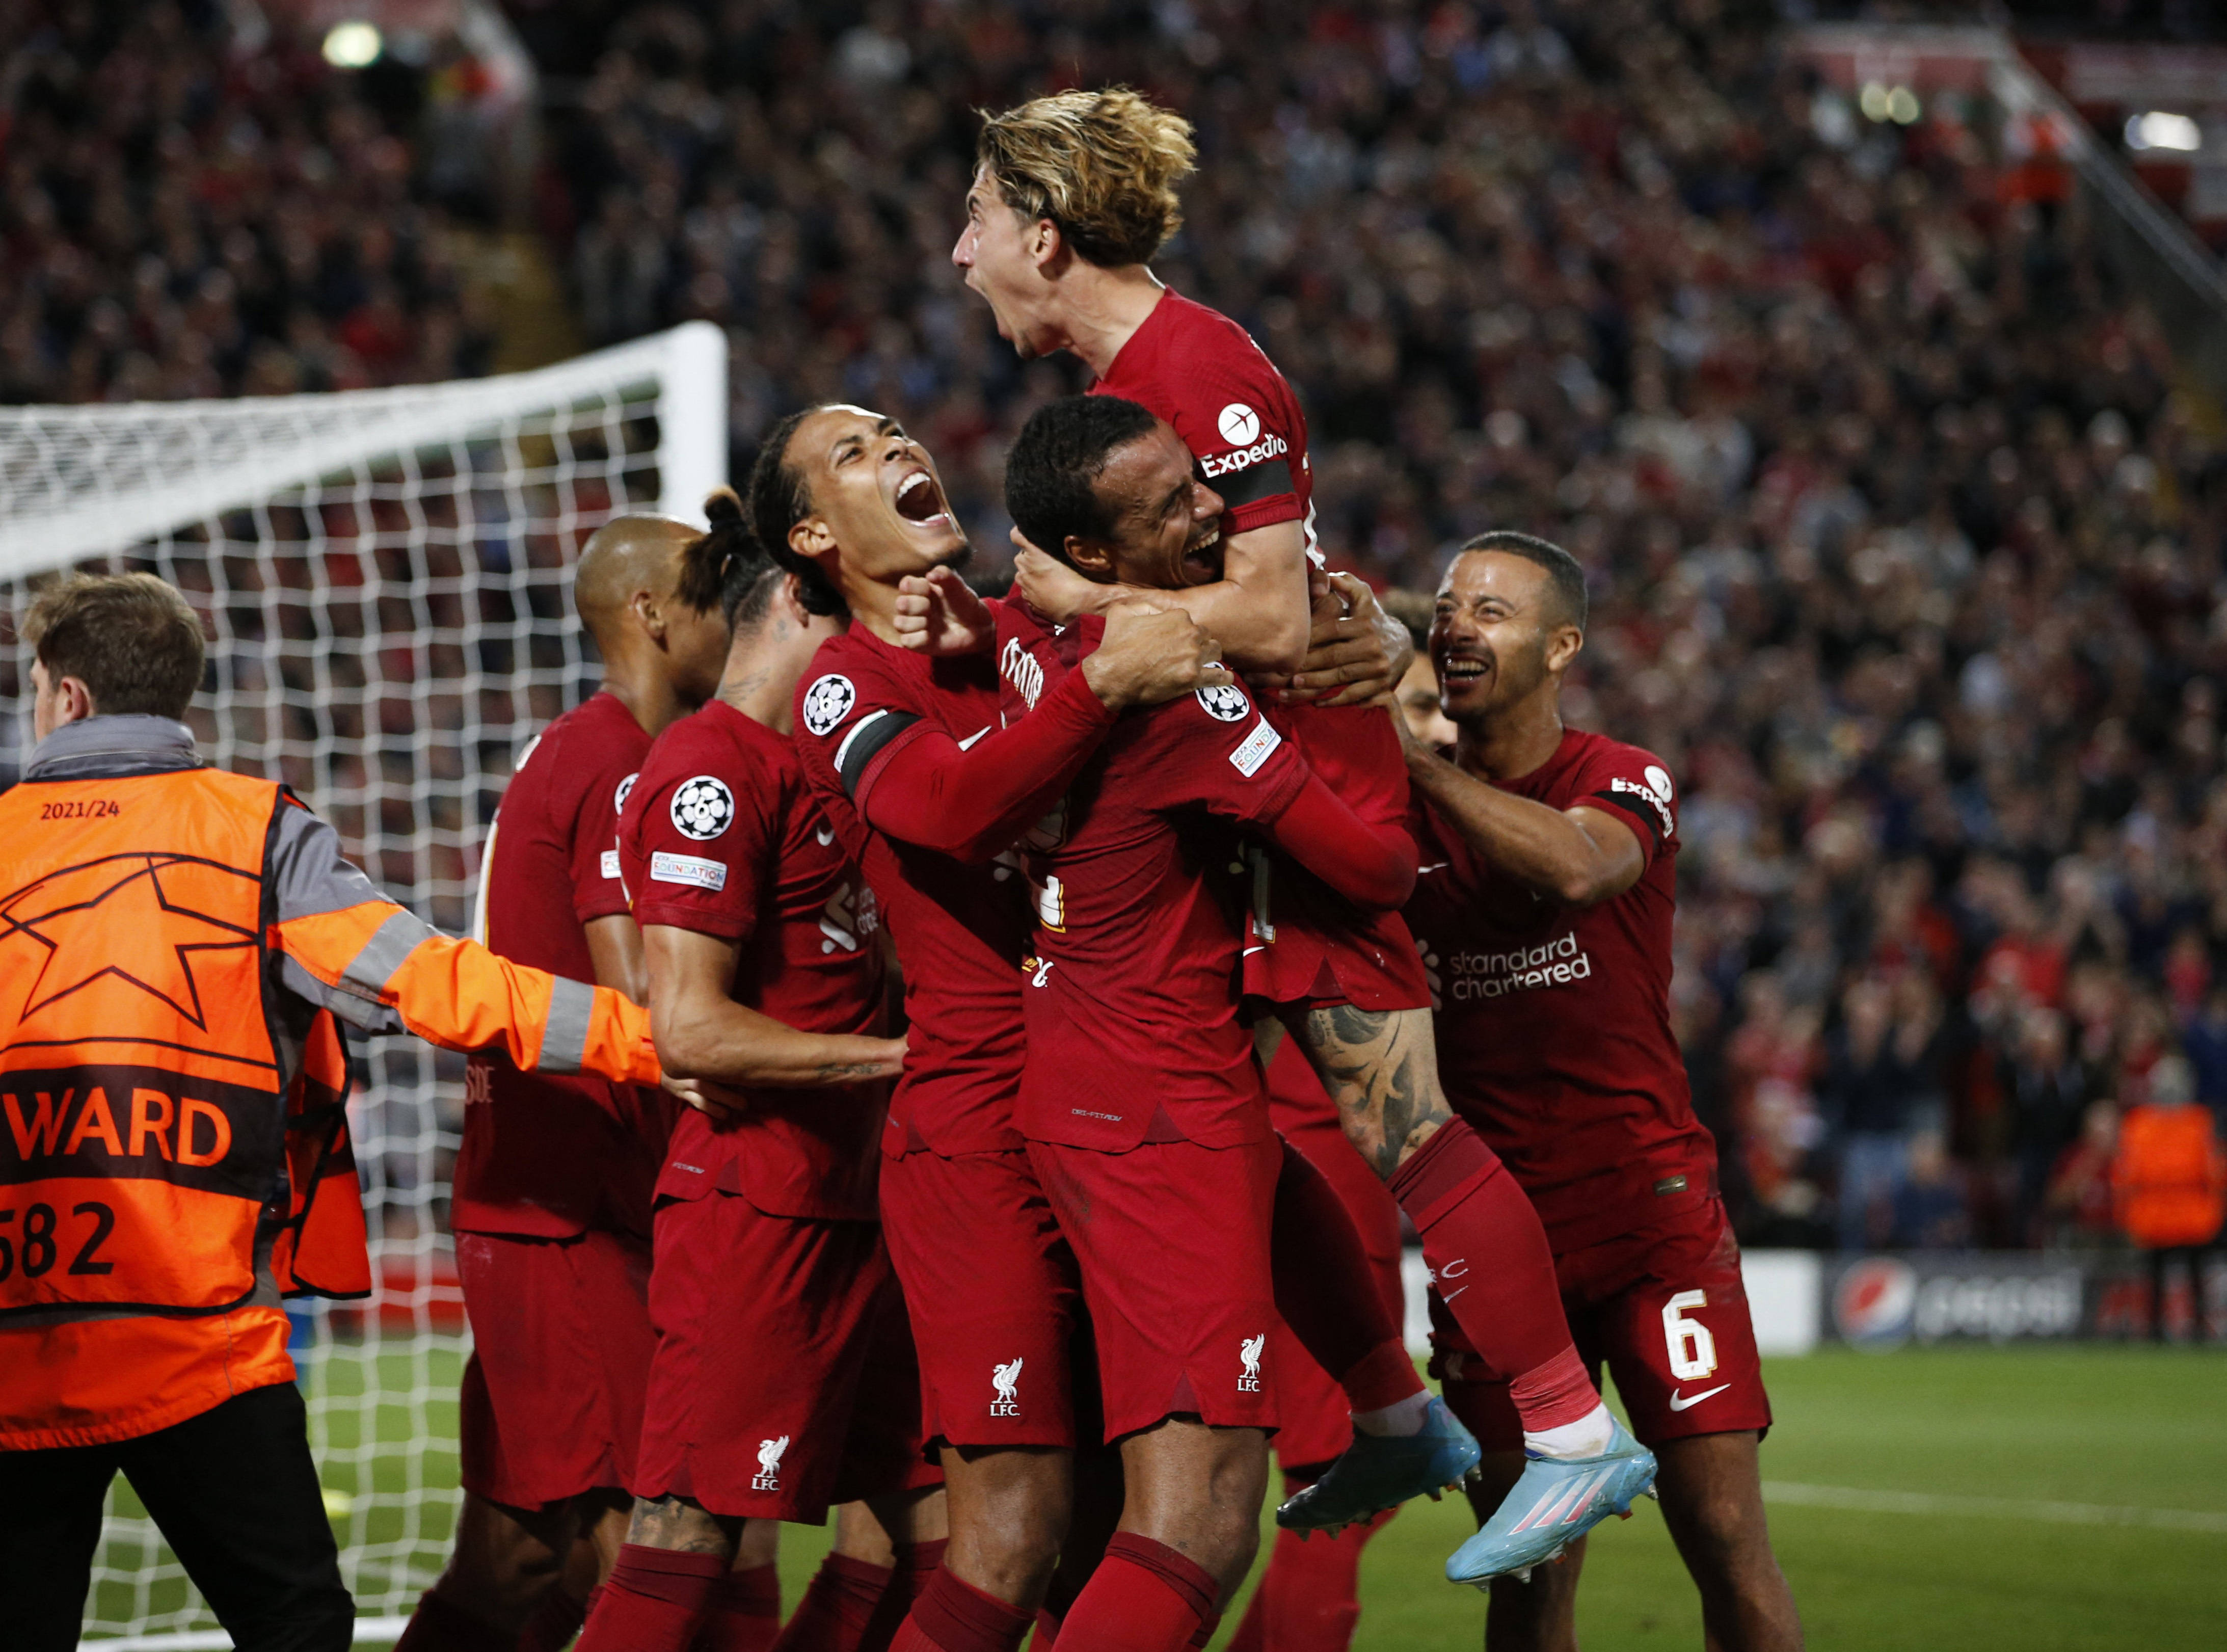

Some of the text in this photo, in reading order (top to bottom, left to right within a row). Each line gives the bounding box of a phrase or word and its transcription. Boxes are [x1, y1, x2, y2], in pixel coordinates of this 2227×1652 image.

[1200, 433, 1288, 478] Expedia
[1233, 746, 1248, 761] UEFA
[1238, 728, 1274, 768] FOUNDA
[41, 800, 120, 820] 2021/24
[694, 796, 710, 820] 6
[654, 862, 724, 882] FOUNDATION
[1450, 930, 1577, 975] standard
[1454, 952, 1591, 1000] chartered
[2, 1086, 232, 1167] WARD
[1661, 1289, 1718, 1381] 6
